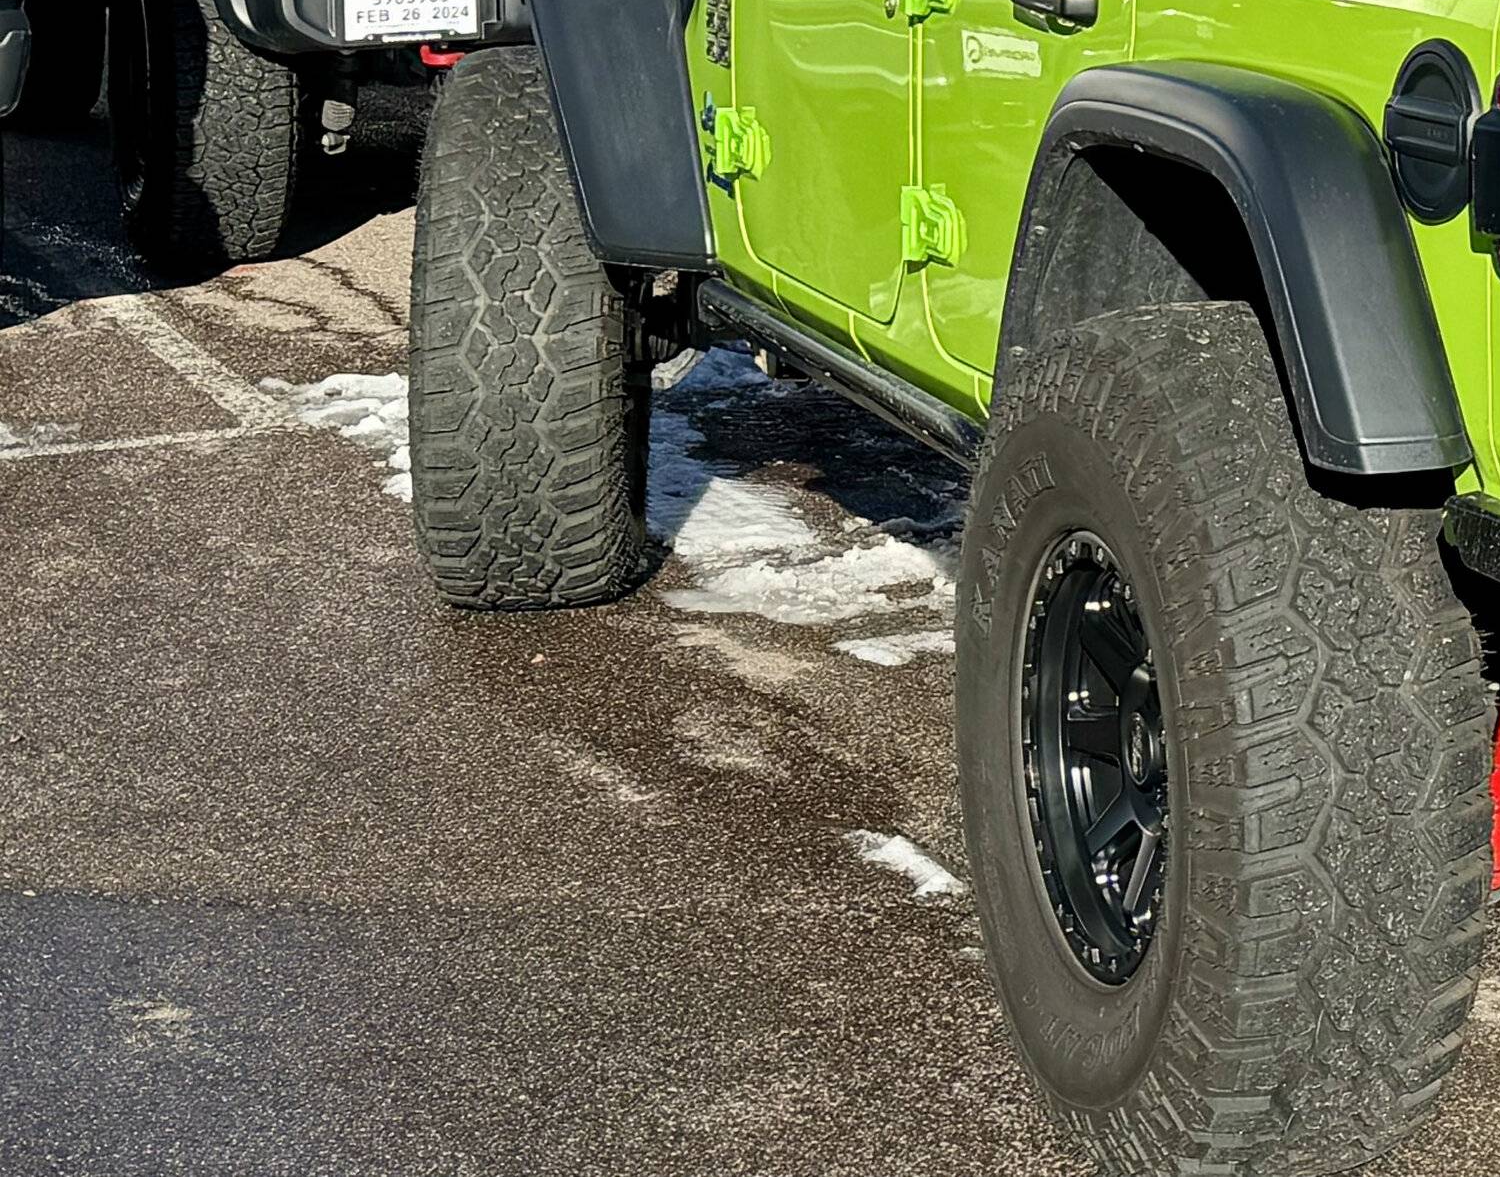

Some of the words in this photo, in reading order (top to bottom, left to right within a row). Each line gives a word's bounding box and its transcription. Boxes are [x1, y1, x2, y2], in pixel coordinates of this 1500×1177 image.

[356, 9, 390, 24] FEB
[402, 8, 421, 21] 26
[432, 6, 469, 20] 2024
[972, 451, 1056, 641] KANATI
